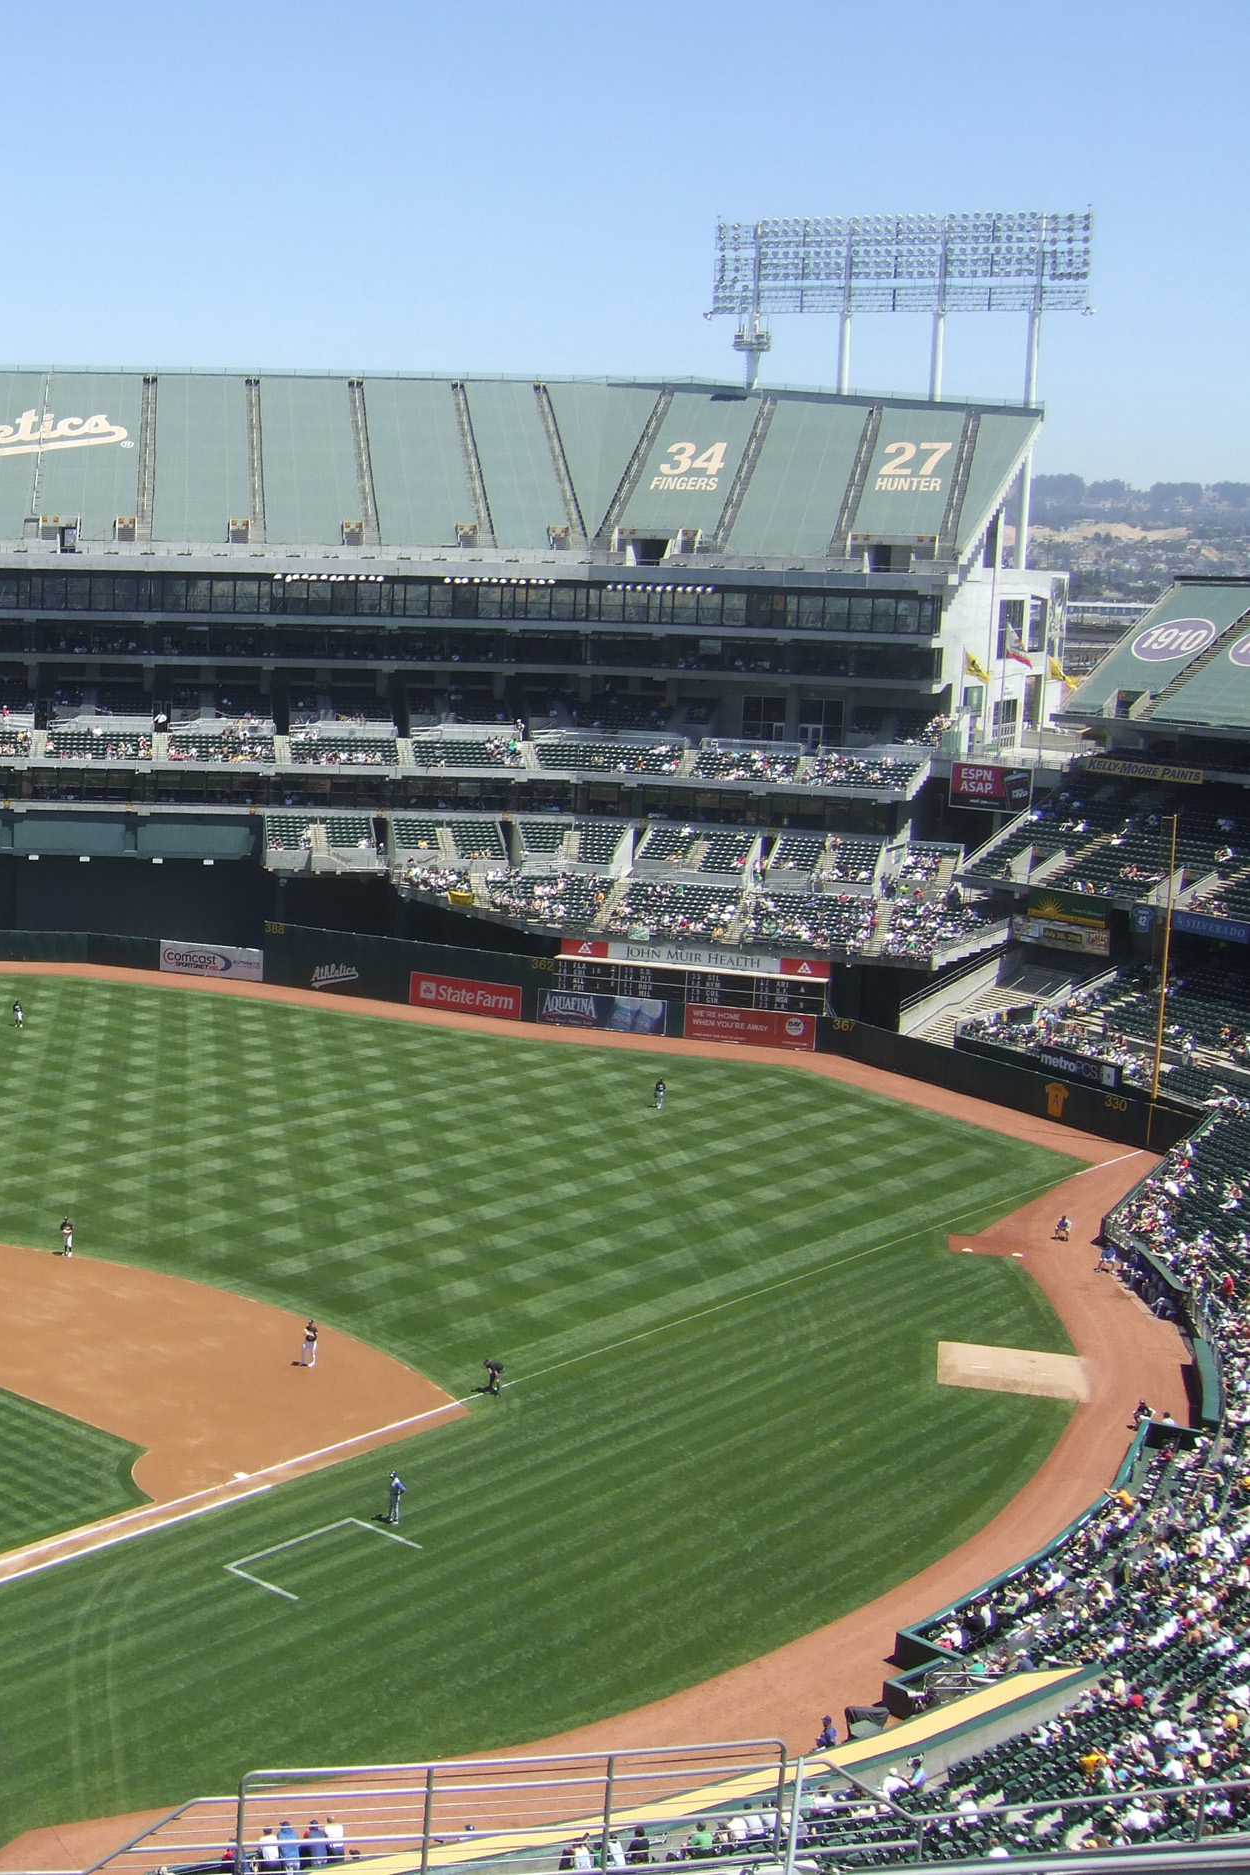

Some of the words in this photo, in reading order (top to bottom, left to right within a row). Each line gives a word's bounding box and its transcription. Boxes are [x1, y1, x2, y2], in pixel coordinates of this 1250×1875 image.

[659, 442, 728, 476] 34
[878, 442, 953, 476] 27
[649, 477, 719, 492] FINGERS
[874, 477, 942, 492] HUNTER
[1141, 627, 1208, 651] 1910
[961, 767, 995, 782] ESPN.
[1088, 759, 1159, 777] KELLY-MOORE
[1161, 767, 1201, 781] PAINTS
[960, 781, 994, 794] ASAP.
[1137, 915, 1147, 927] 42
[1185, 916, 1246, 938] SILVERADO
[265, 923, 285, 935] 388
[167, 951, 216, 965] comcast
[531, 958, 554, 971] 362
[626, 946, 661, 959] JOHN
[666, 949, 702, 963] MUIR
[708, 952, 760, 969] HEALTH
[175, 961, 208, 970] SPORTSNET
[311, 963, 359, 989] Athletics
[437, 985, 475, 1005] State
[475, 990, 514, 1010] Farm
[542, 991, 597, 1019] AQUAFINA
[693, 1009, 717, 1018] WE'RE
[718, 1012, 741, 1021] HOME
[692, 1018, 715, 1027] WHEN
[717, 1020, 746, 1030] YOU'RE
[746, 1024, 769, 1032] AWAY
[832, 1019, 856, 1032] 367
[1040, 1053, 1098, 1080] metroPCS
[1104, 1094, 1128, 1112] 330
